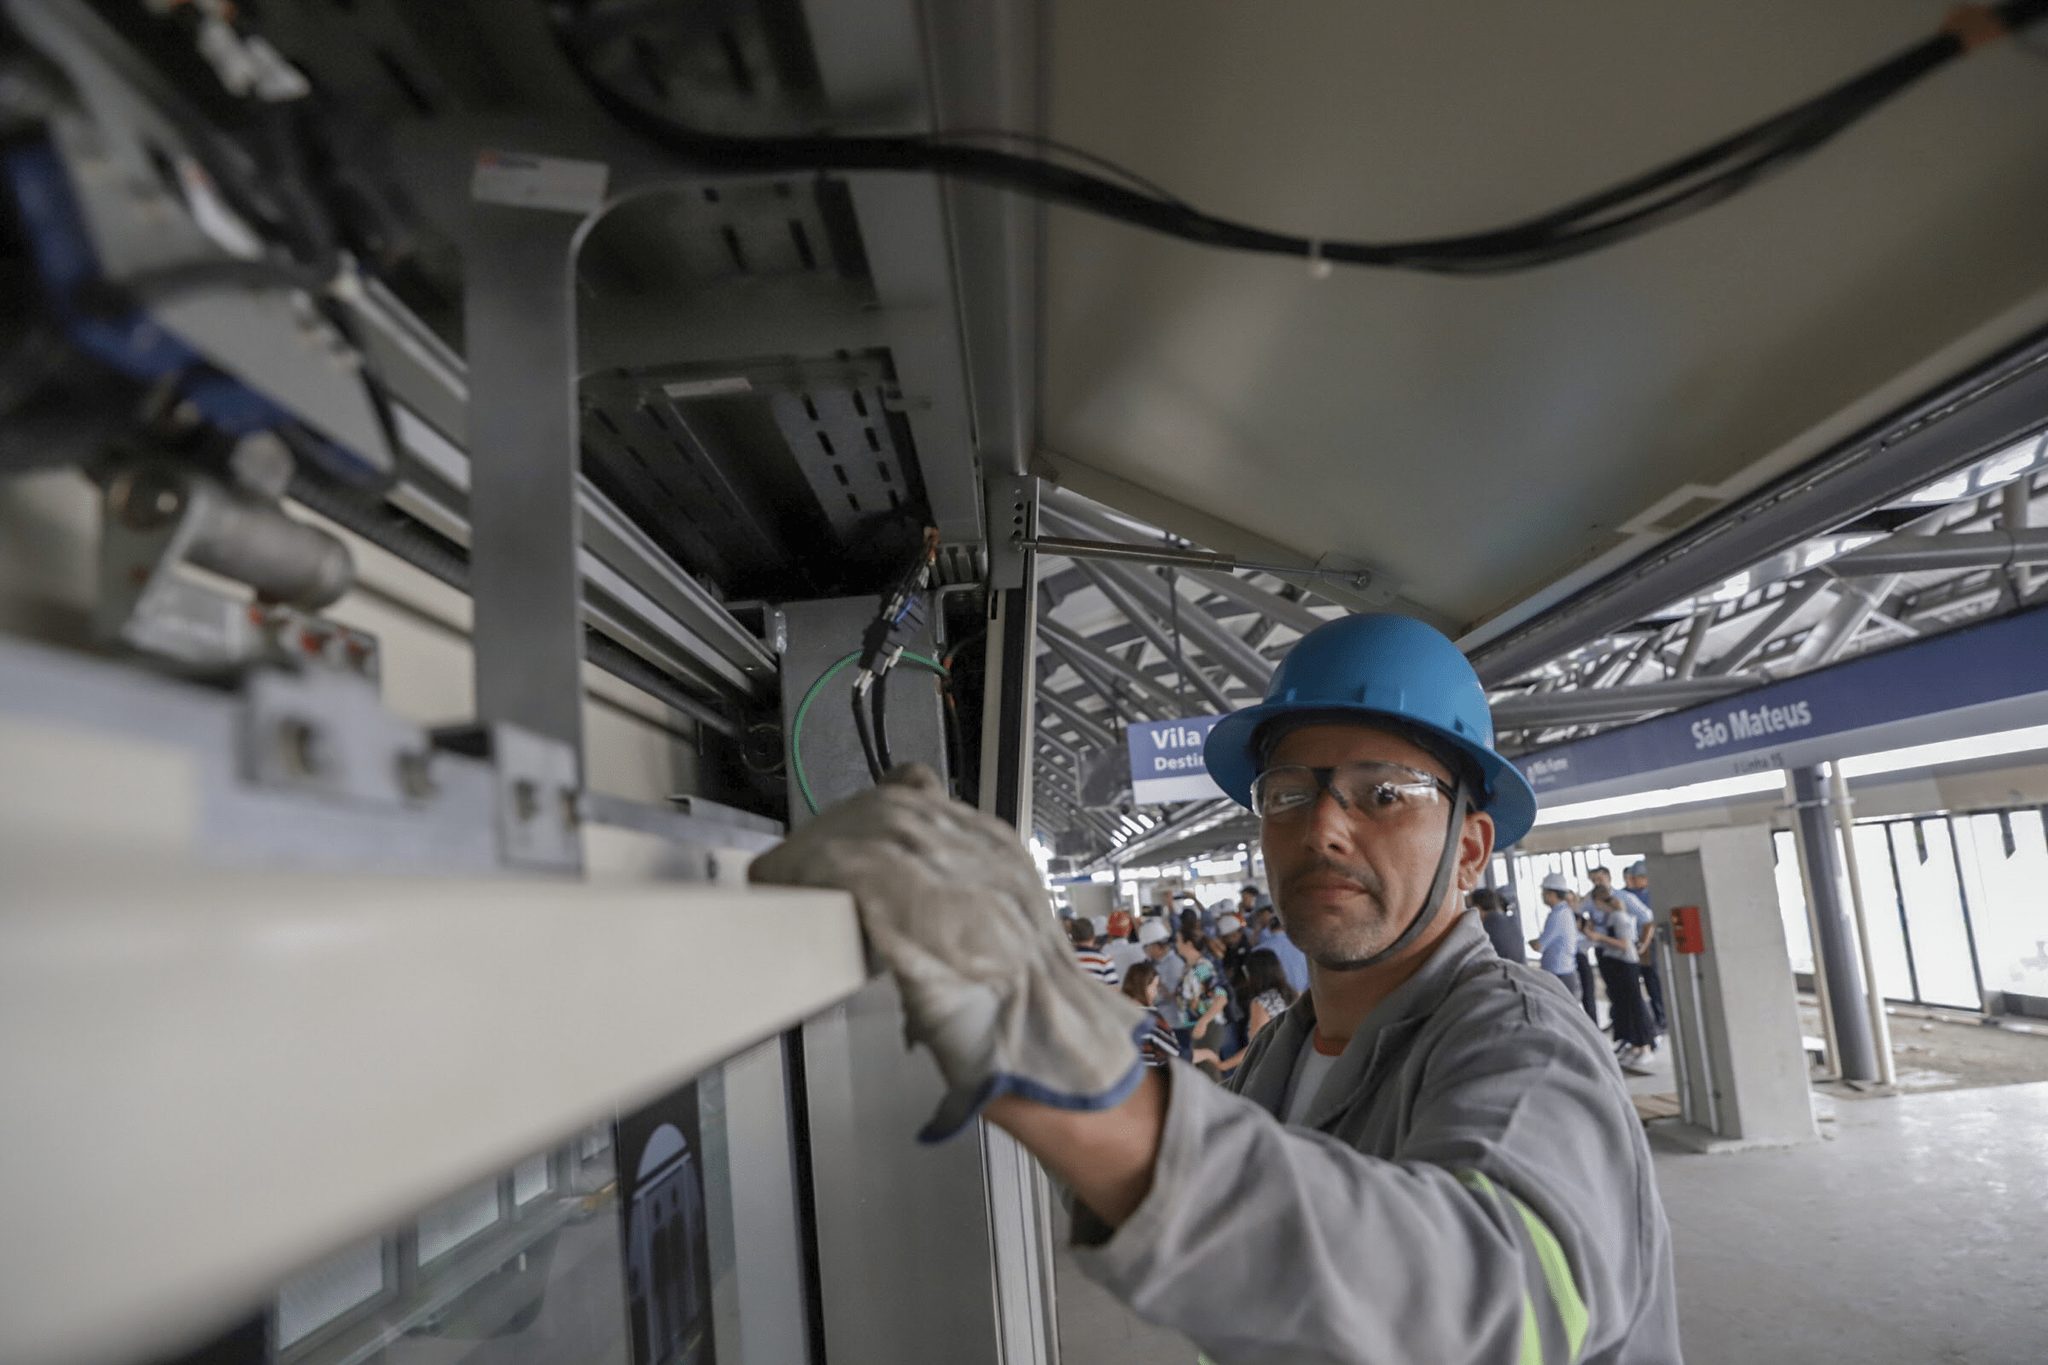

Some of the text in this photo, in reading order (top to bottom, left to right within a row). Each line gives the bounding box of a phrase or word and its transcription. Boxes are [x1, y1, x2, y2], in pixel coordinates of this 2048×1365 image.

[1151, 727, 1201, 750] Vila
[1691, 701, 1812, 749] São Mateus
